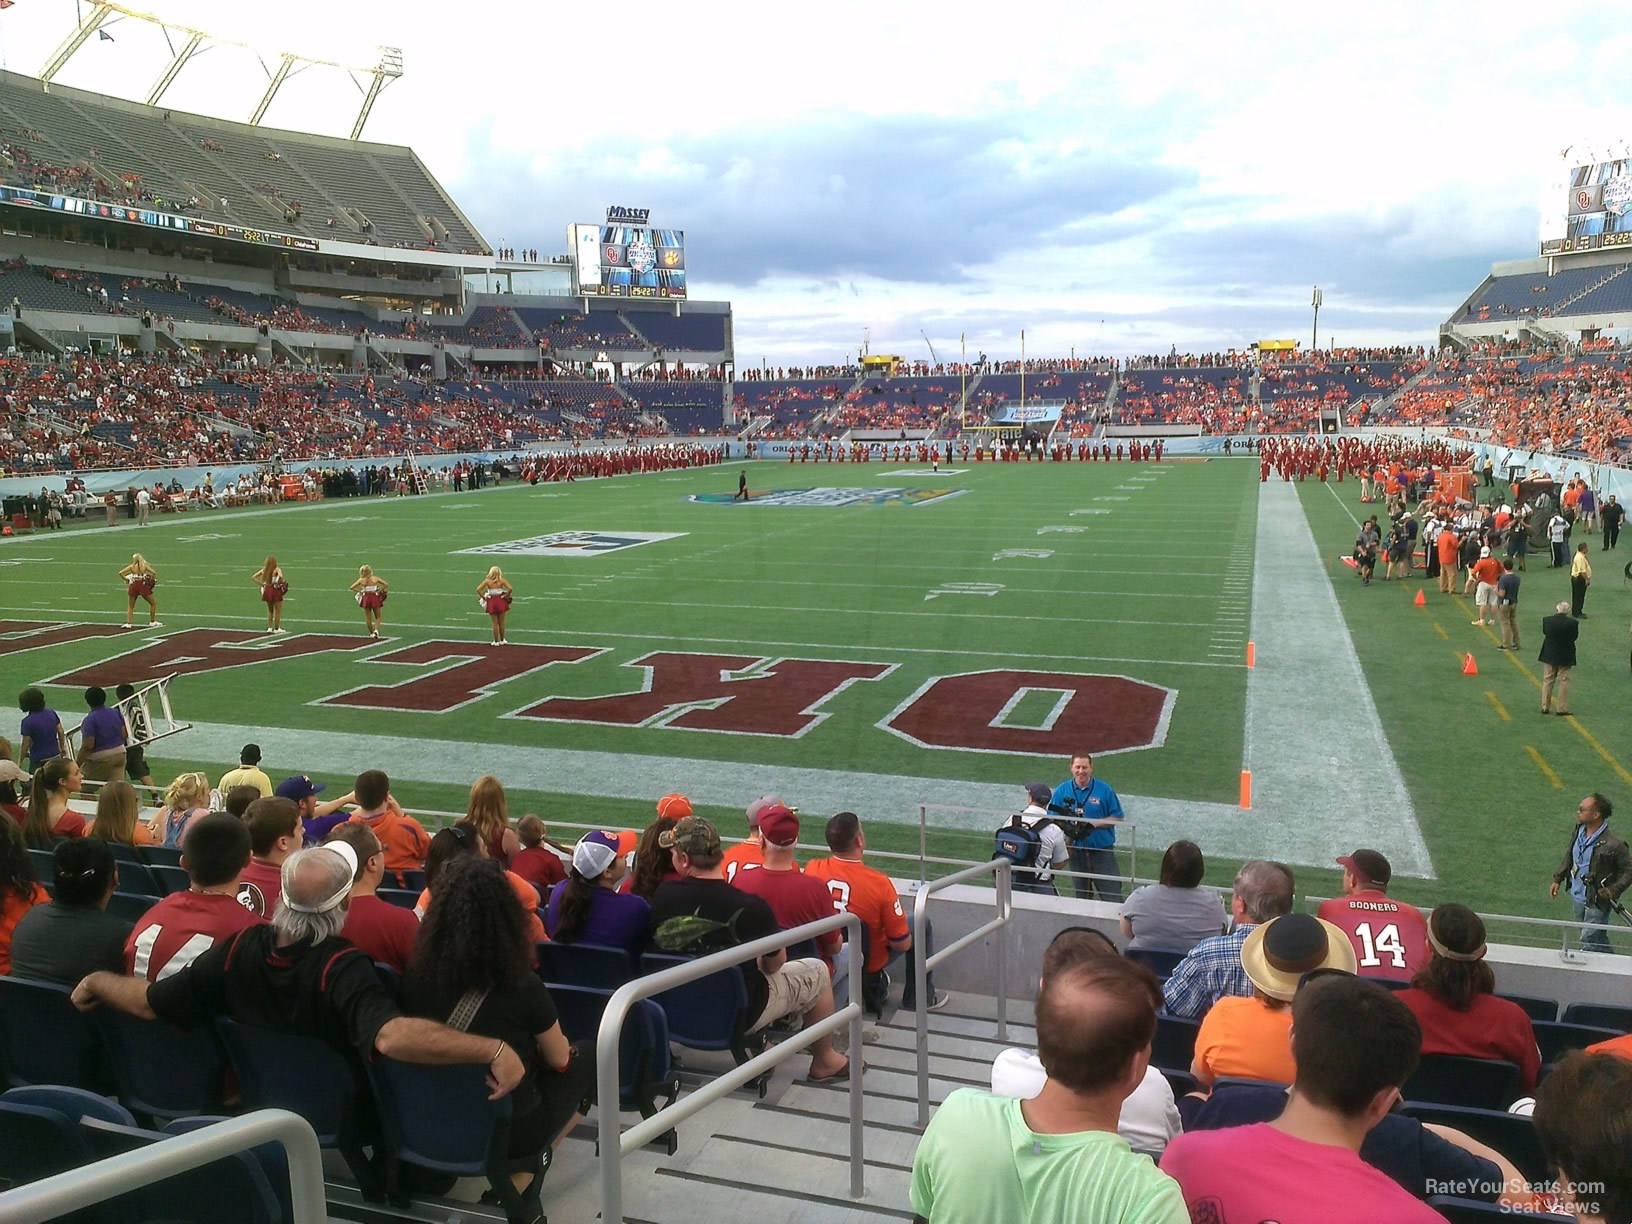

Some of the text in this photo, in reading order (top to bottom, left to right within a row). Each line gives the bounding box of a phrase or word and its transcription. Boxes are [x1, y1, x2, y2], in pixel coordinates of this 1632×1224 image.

[609, 205, 650, 219] MASSEY
[218, 226, 224, 235] 0
[286, 236, 291, 246] 0
[1564, 239, 1572, 250] 0
[1604, 232, 1629, 244] 25:22
[600, 285, 606, 295] 0
[632, 287, 651, 296] 25:22
[661, 287, 667, 297] 0
[727, 861, 762, 884] 1
[827, 879, 850, 913] 3
[1349, 901, 1399, 913] SOONERS
[1355, 921, 1407, 969] 14
[542, 1151, 548, 1166] E
